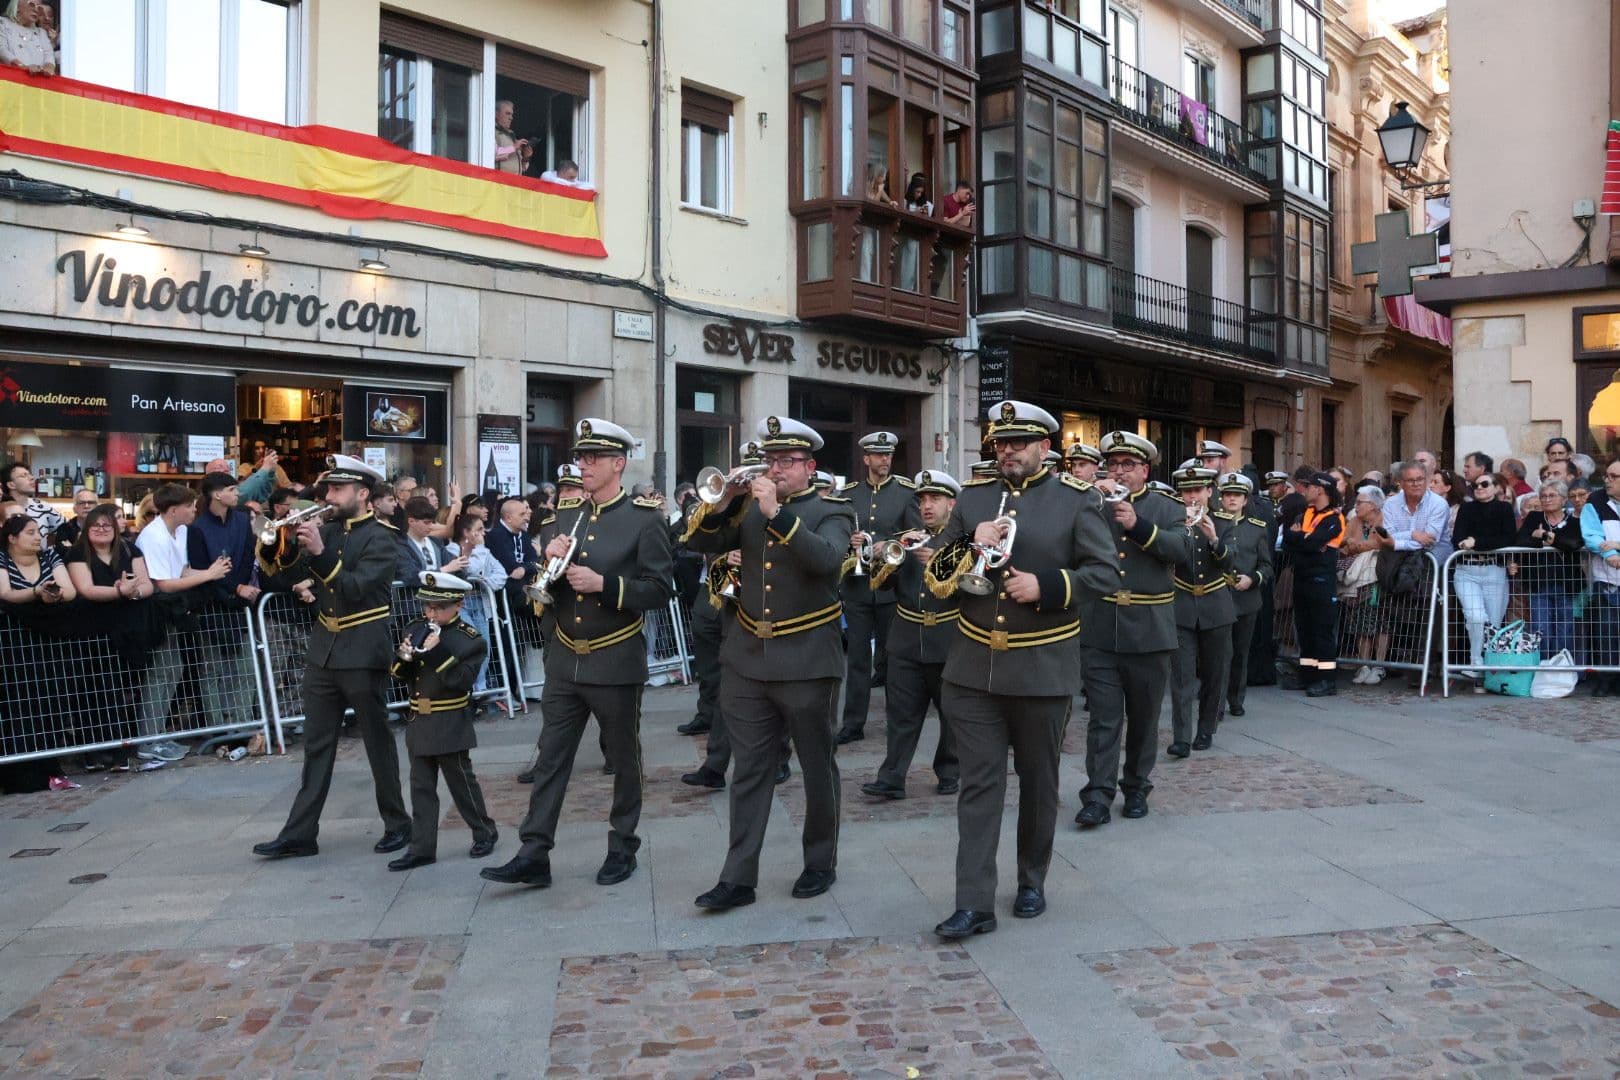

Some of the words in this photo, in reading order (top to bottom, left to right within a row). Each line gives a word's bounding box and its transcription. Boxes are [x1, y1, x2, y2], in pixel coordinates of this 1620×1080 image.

[57, 249, 421, 337] Vinodotoro.com
[702, 320, 796, 364] SEVER
[817, 340, 922, 379] SEGUROS
[981, 377, 1003, 385] QUESOS
[16, 390, 108, 406] Vinodotoro.com
[131, 394, 158, 410] Pan
[163, 396, 226, 414] Artesano
